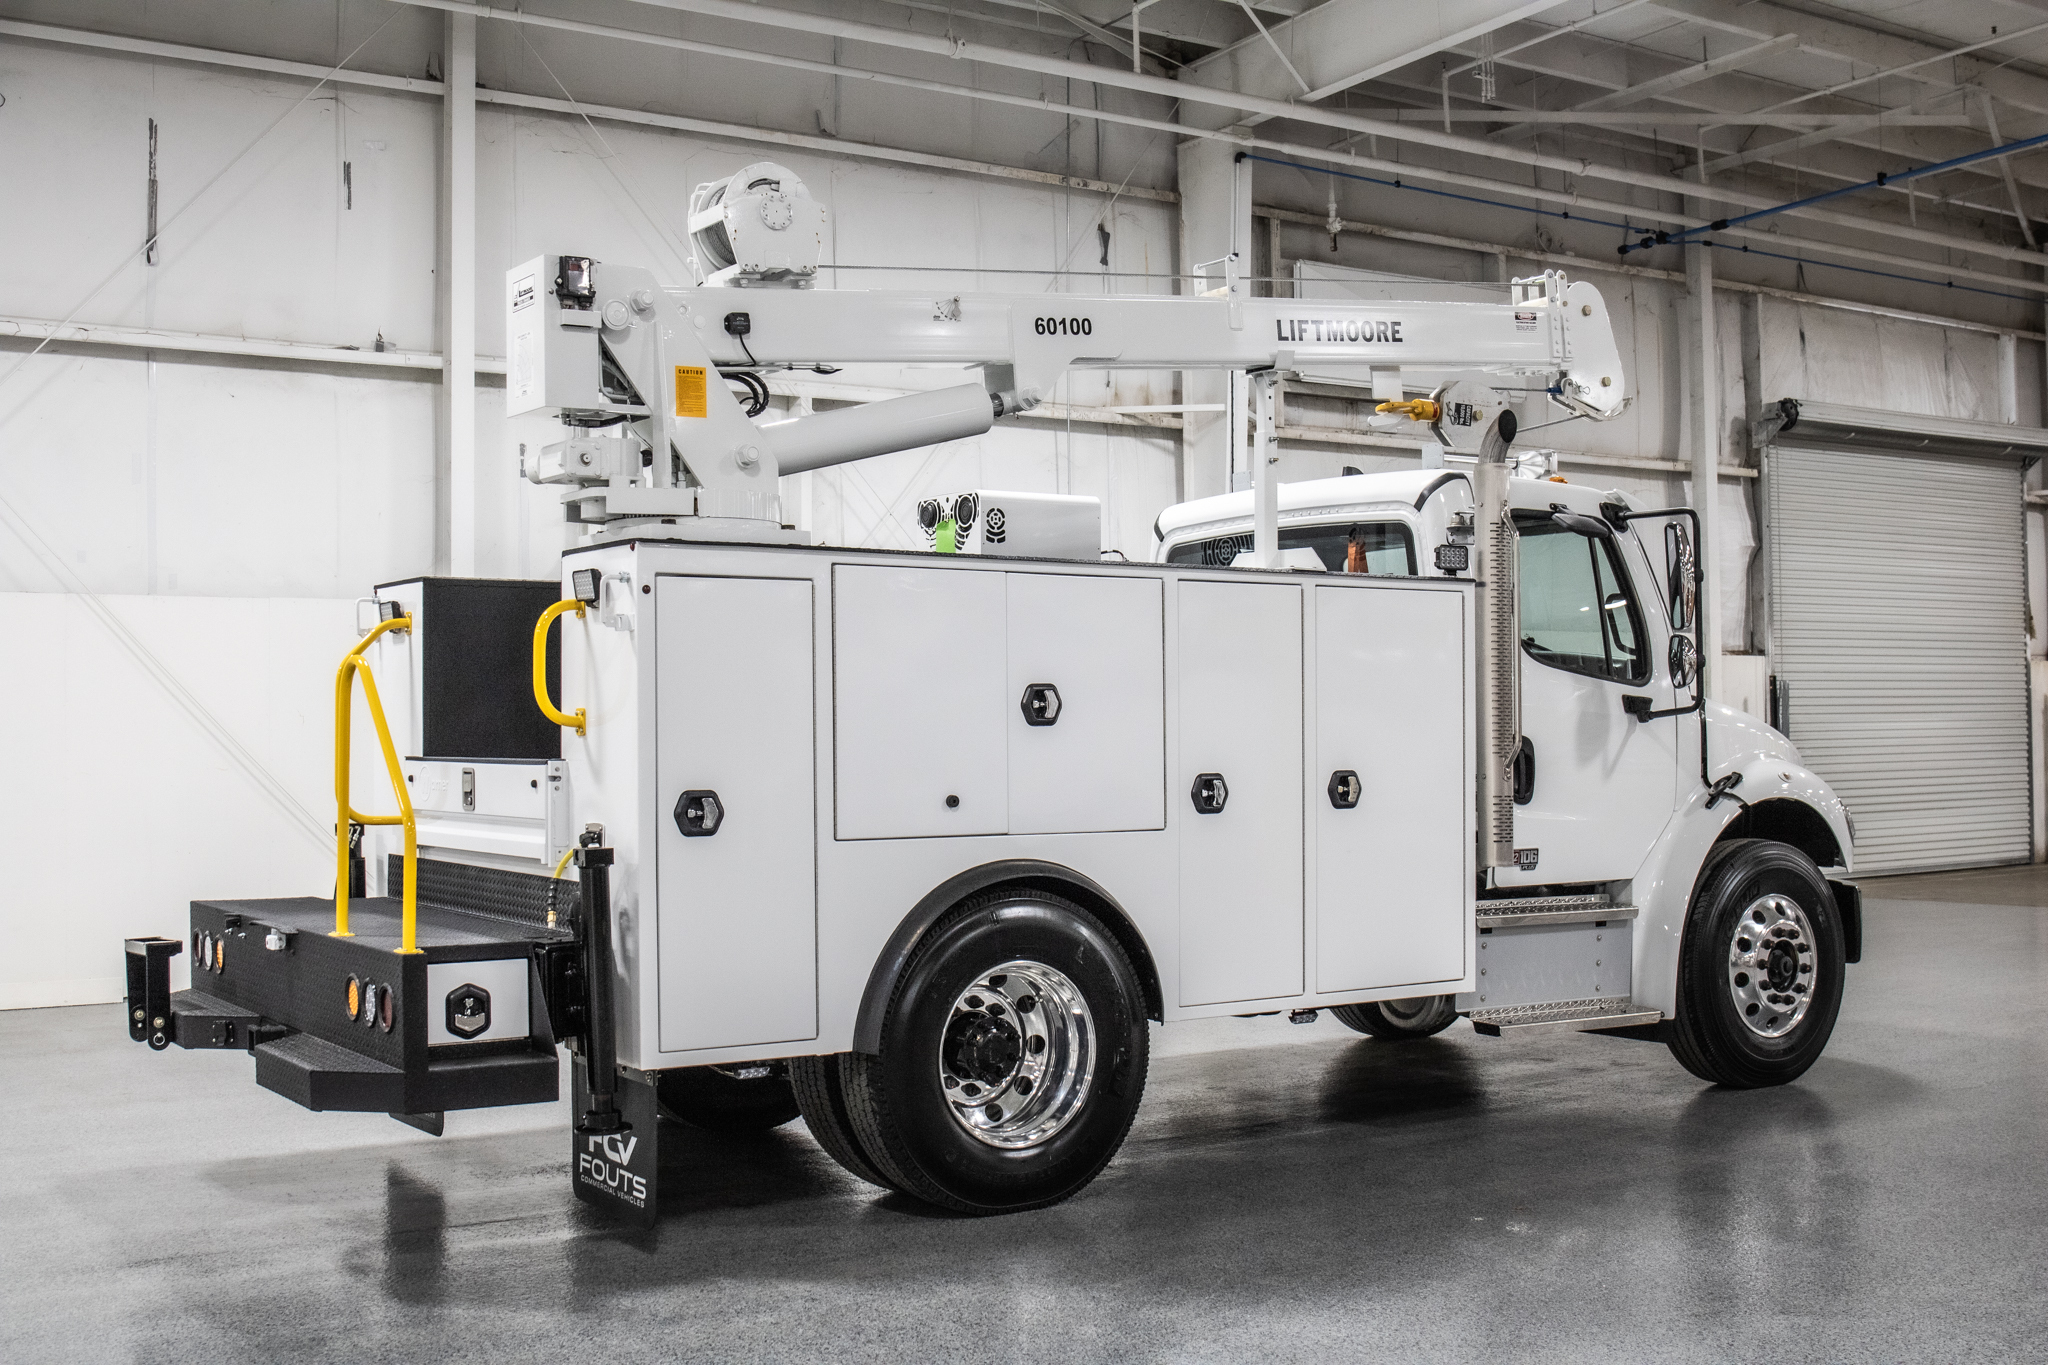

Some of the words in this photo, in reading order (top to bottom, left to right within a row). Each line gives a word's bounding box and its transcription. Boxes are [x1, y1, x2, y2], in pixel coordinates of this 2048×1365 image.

[1034, 317, 1092, 336] 60100
[1276, 319, 1404, 342] LIFTMOORE
[678, 368, 704, 376] CAUTION
[1520, 850, 1538, 864] 106
[580, 1152, 647, 1200] FOUTS
[580, 1174, 616, 1195] COMMERCIAL
[617, 1190, 645, 1208] VEHICLES
